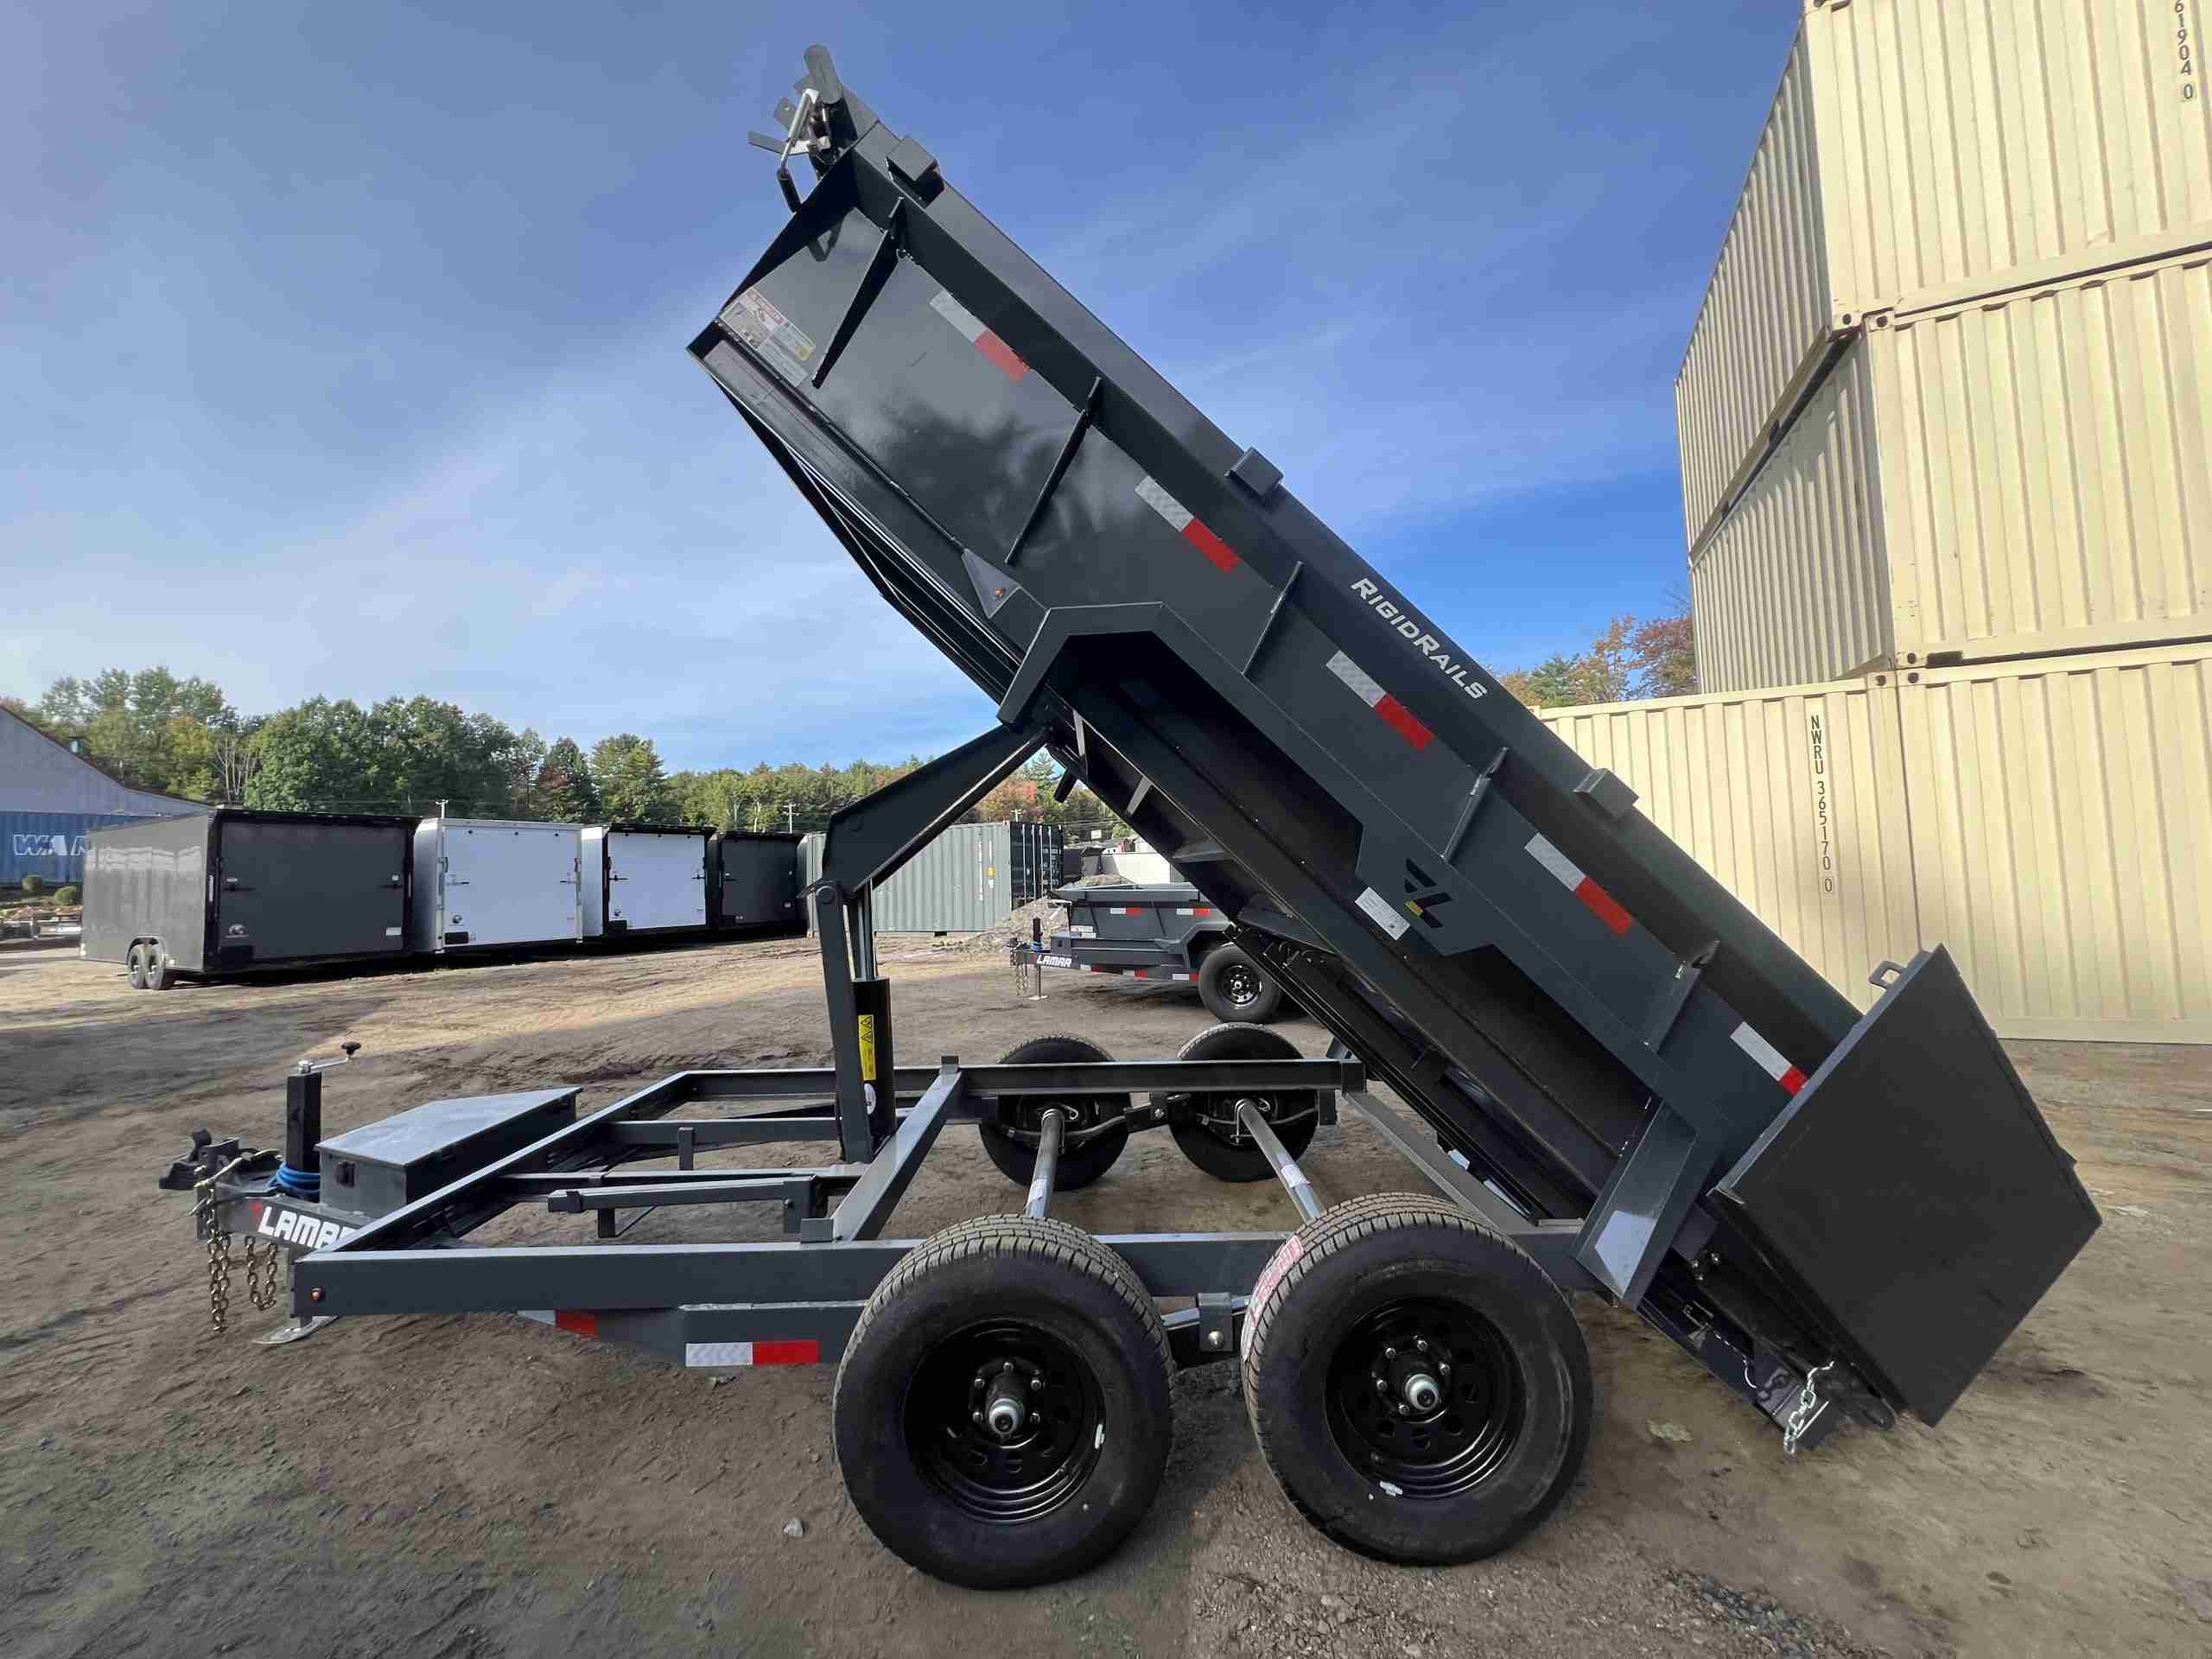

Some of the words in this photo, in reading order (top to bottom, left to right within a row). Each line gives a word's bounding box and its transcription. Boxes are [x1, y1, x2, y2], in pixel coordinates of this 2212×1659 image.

[1350, 577, 1488, 699] RIGIDRAILS
[1811, 715, 1824, 774] NWRU
[1817, 780, 1831, 870] 365170
[1824, 878, 1833, 892] 0
[1037, 954, 1072, 968] LAMAR
[257, 1206, 359, 1249] LAMA
